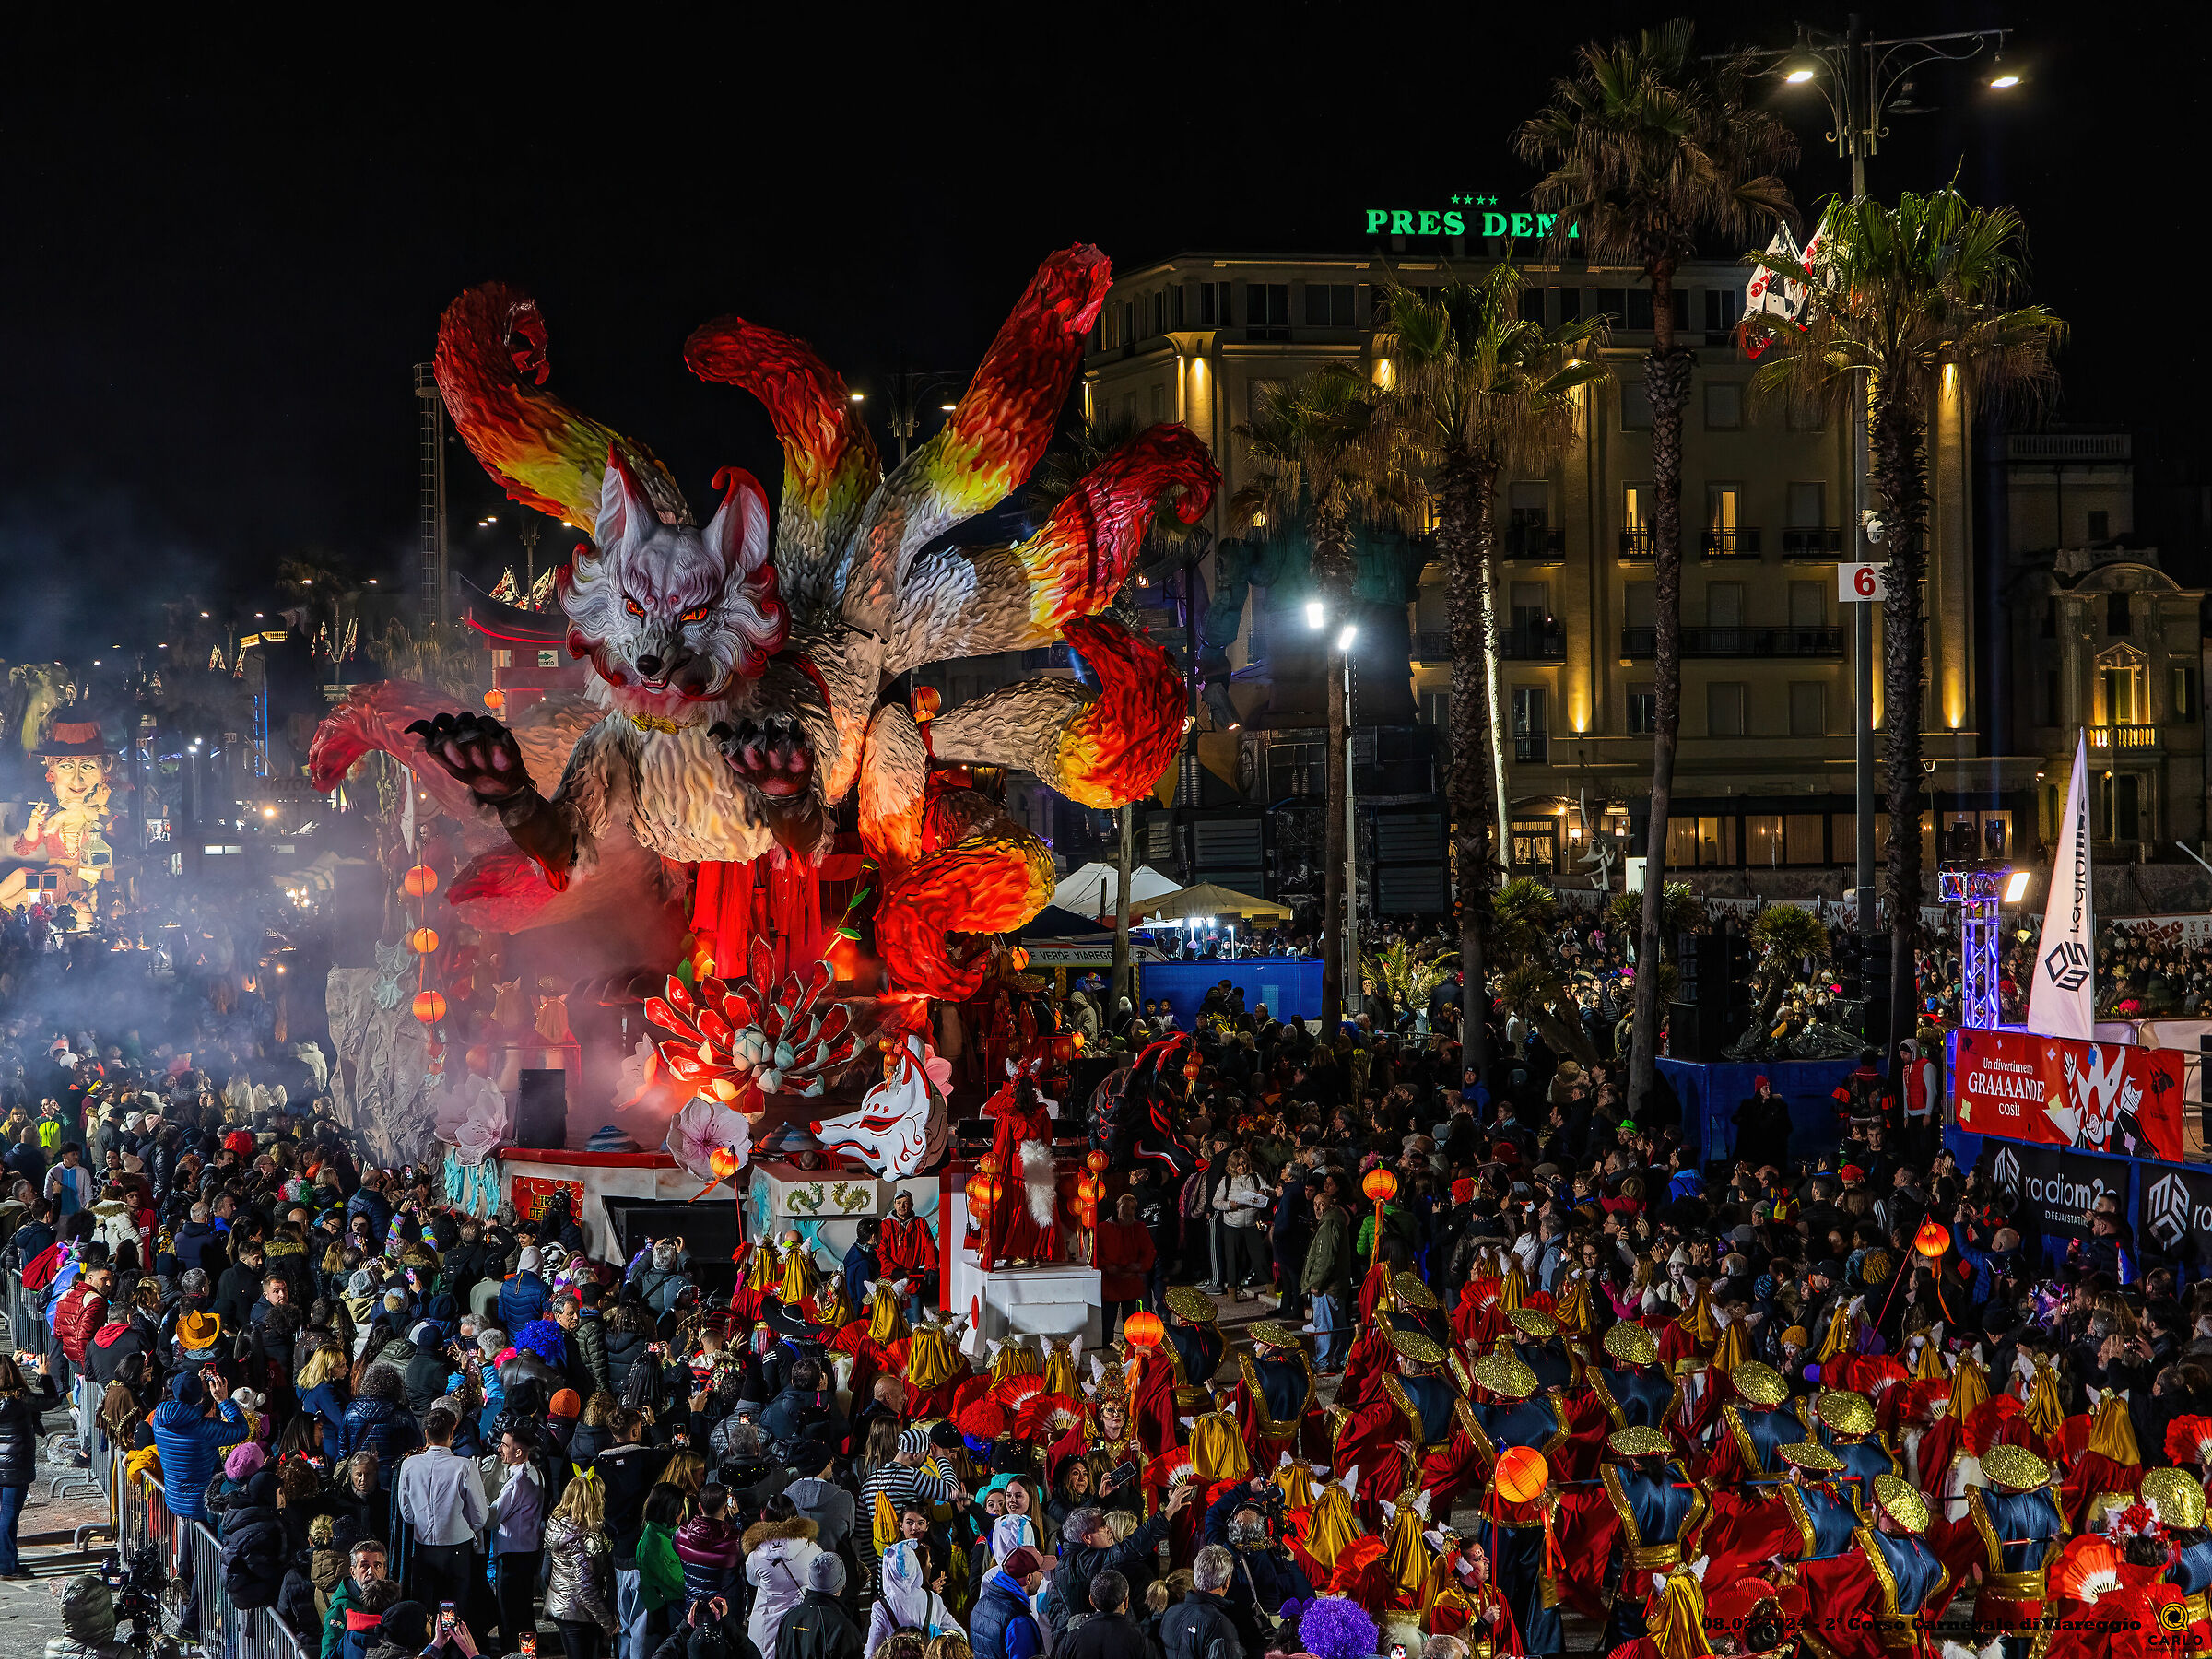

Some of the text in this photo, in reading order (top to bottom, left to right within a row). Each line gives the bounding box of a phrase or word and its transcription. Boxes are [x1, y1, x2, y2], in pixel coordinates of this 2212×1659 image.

[1853, 567, 1876, 596] 6
[1039, 951, 1072, 960] VERDE
[1073, 950, 1113, 960] VIAREGG
[1983, 1057, 1993, 1070] Un
[1968, 1071, 2045, 1103] GRAAAANDE
[532, 1194, 552, 1207] L'IR
[2025, 1172, 2118, 1211] radiom2
[2044, 1209, 2088, 1227] DEEJAYSTATI
